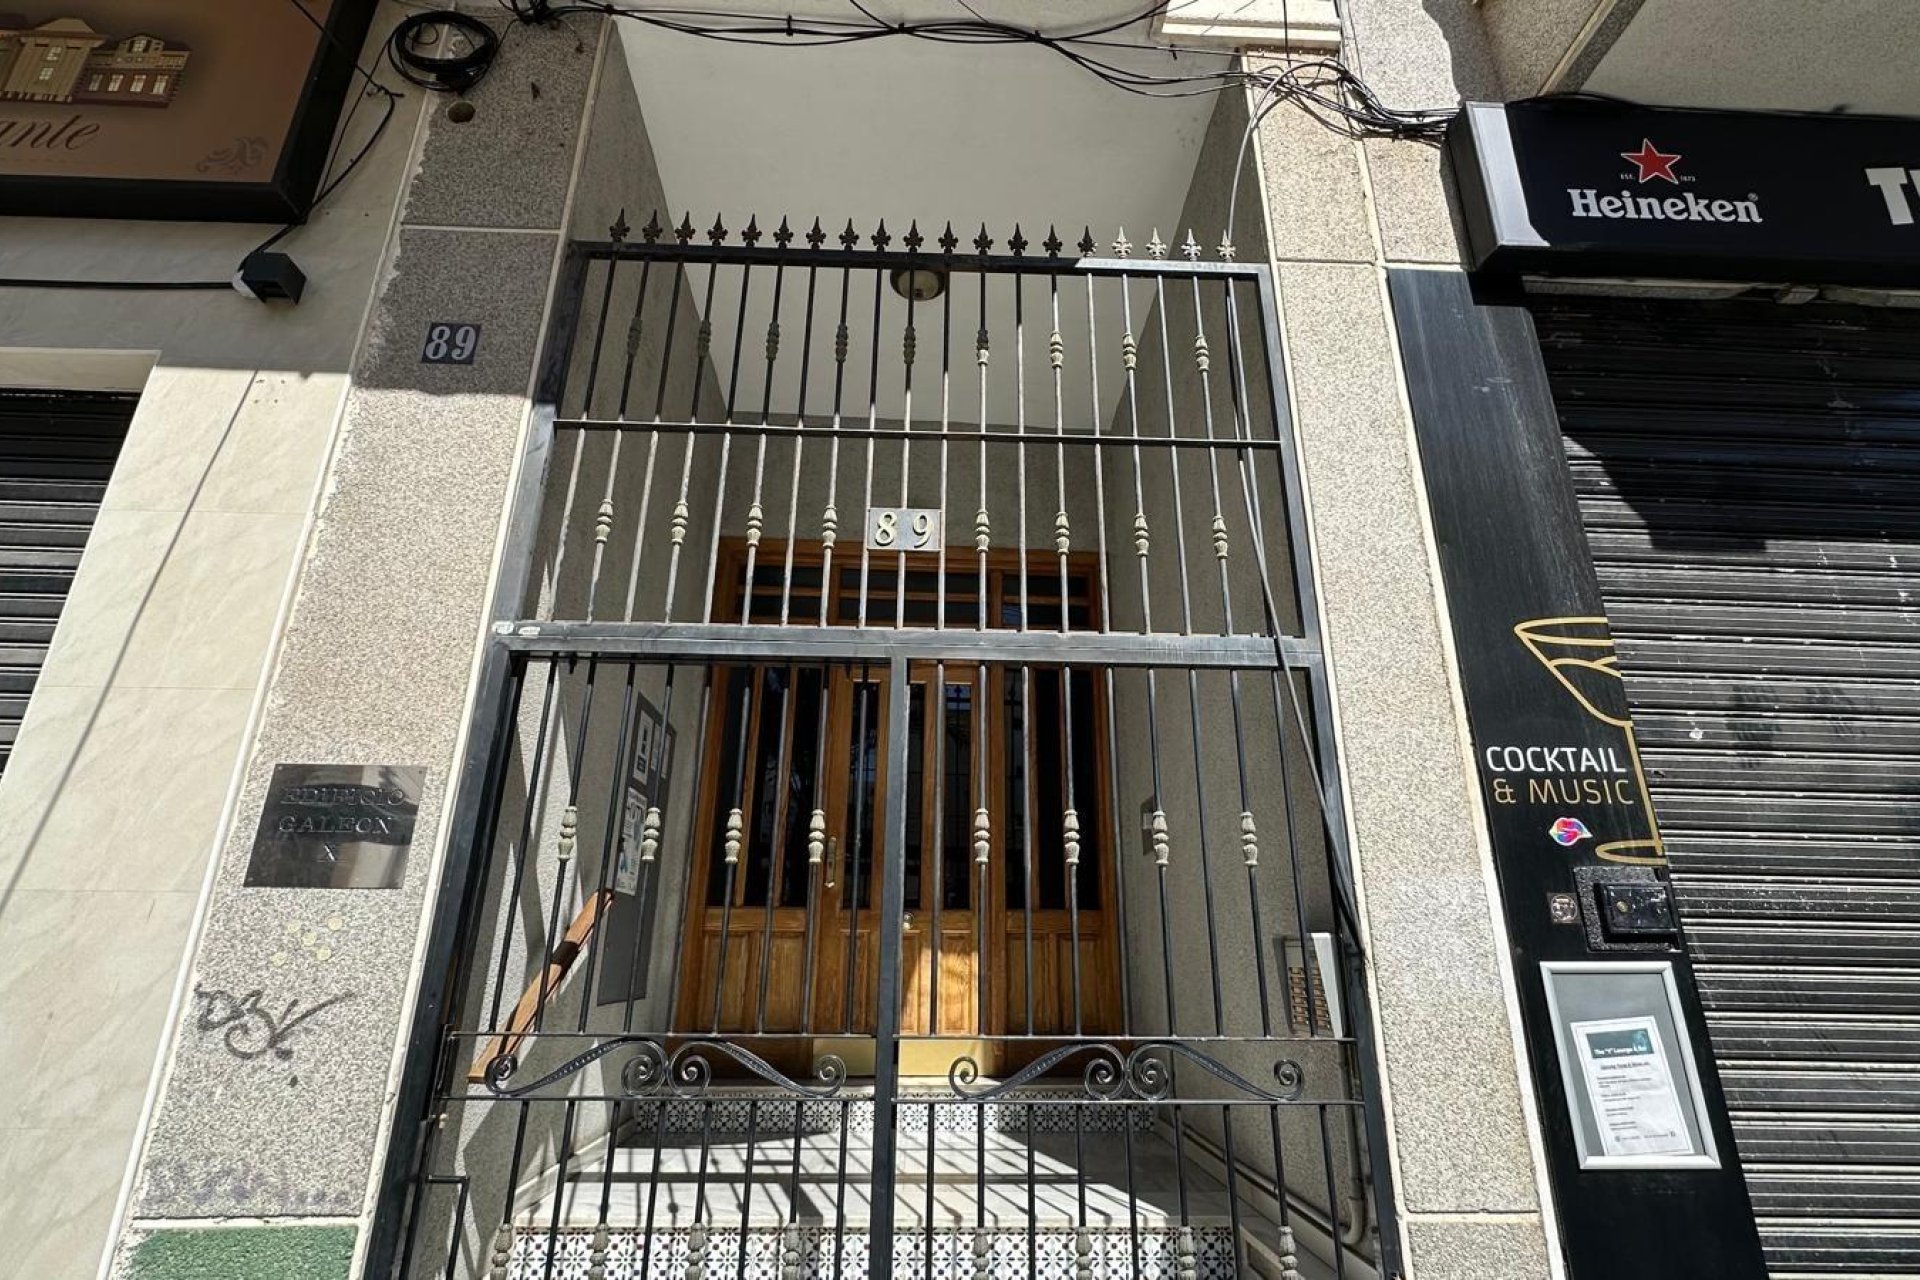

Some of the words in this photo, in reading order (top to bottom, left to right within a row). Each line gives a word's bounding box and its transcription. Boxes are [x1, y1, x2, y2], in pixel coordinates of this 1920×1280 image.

[1567, 188, 1763, 224] Heineken
[1864, 167, 1920, 225] T
[426, 326, 476, 361] 89
[874, 511, 935, 549] 89
[1486, 746, 1627, 773] COCKTAIL
[1492, 778, 1516, 805] &
[1528, 778, 1634, 805] MUSIC
[278, 815, 393, 834] GALEON
